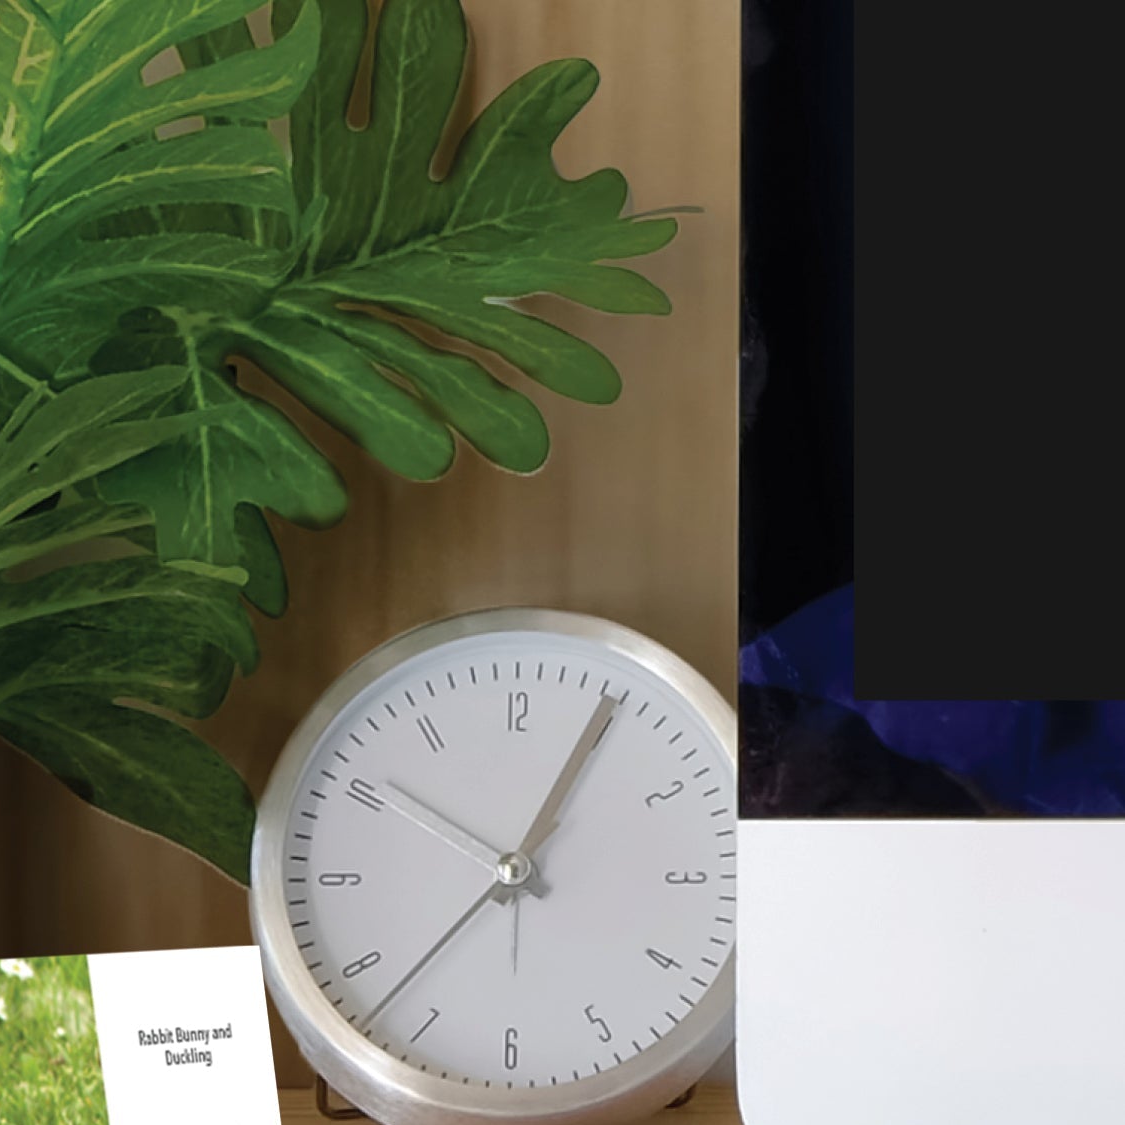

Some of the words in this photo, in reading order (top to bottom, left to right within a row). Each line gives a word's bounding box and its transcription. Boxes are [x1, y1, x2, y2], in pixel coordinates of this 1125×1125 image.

[507, 691, 529, 732] 12
[416, 714, 445, 753] 11
[345, 777, 385, 812] 10
[644, 780, 685, 808] 2
[318, 872, 363, 887] 9
[664, 870, 708, 885] 3
[341, 950, 382, 979] 8
[644, 948, 683, 970] 4
[138, 1028, 174, 1046] Rabbit
[175, 1027, 209, 1045] Bunny
[212, 1022, 233, 1040] and
[409, 1007, 441, 1044] 7
[583, 1003, 613, 1043] 5
[165, 1047, 213, 1067] Duckling
[504, 1026, 519, 1071] 6
